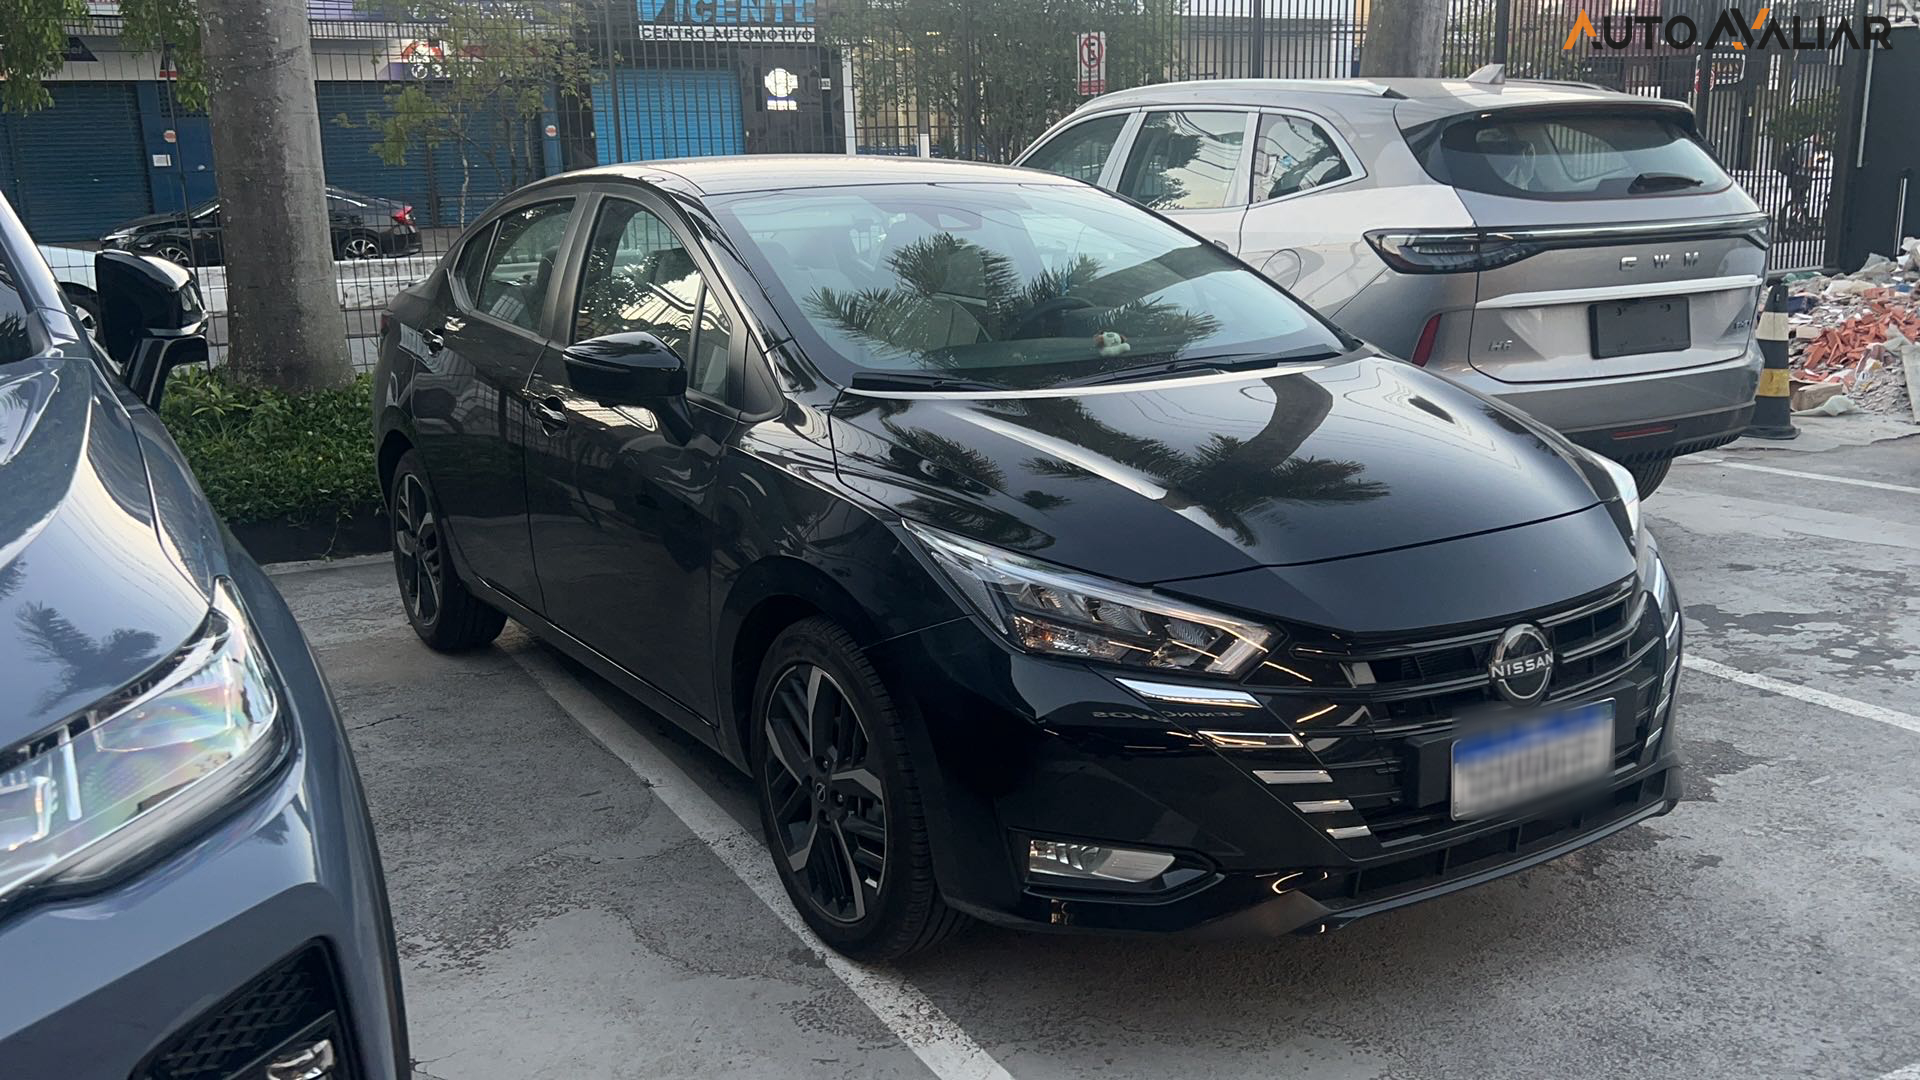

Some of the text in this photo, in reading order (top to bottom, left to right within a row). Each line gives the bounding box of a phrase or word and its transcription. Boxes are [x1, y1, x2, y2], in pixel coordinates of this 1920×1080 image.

[636, 0, 817, 23] VICENTE
[641, 27, 814, 41] CENTRO AUTOMOTIVO
[1491, 653, 1554, 679] NISSAN
